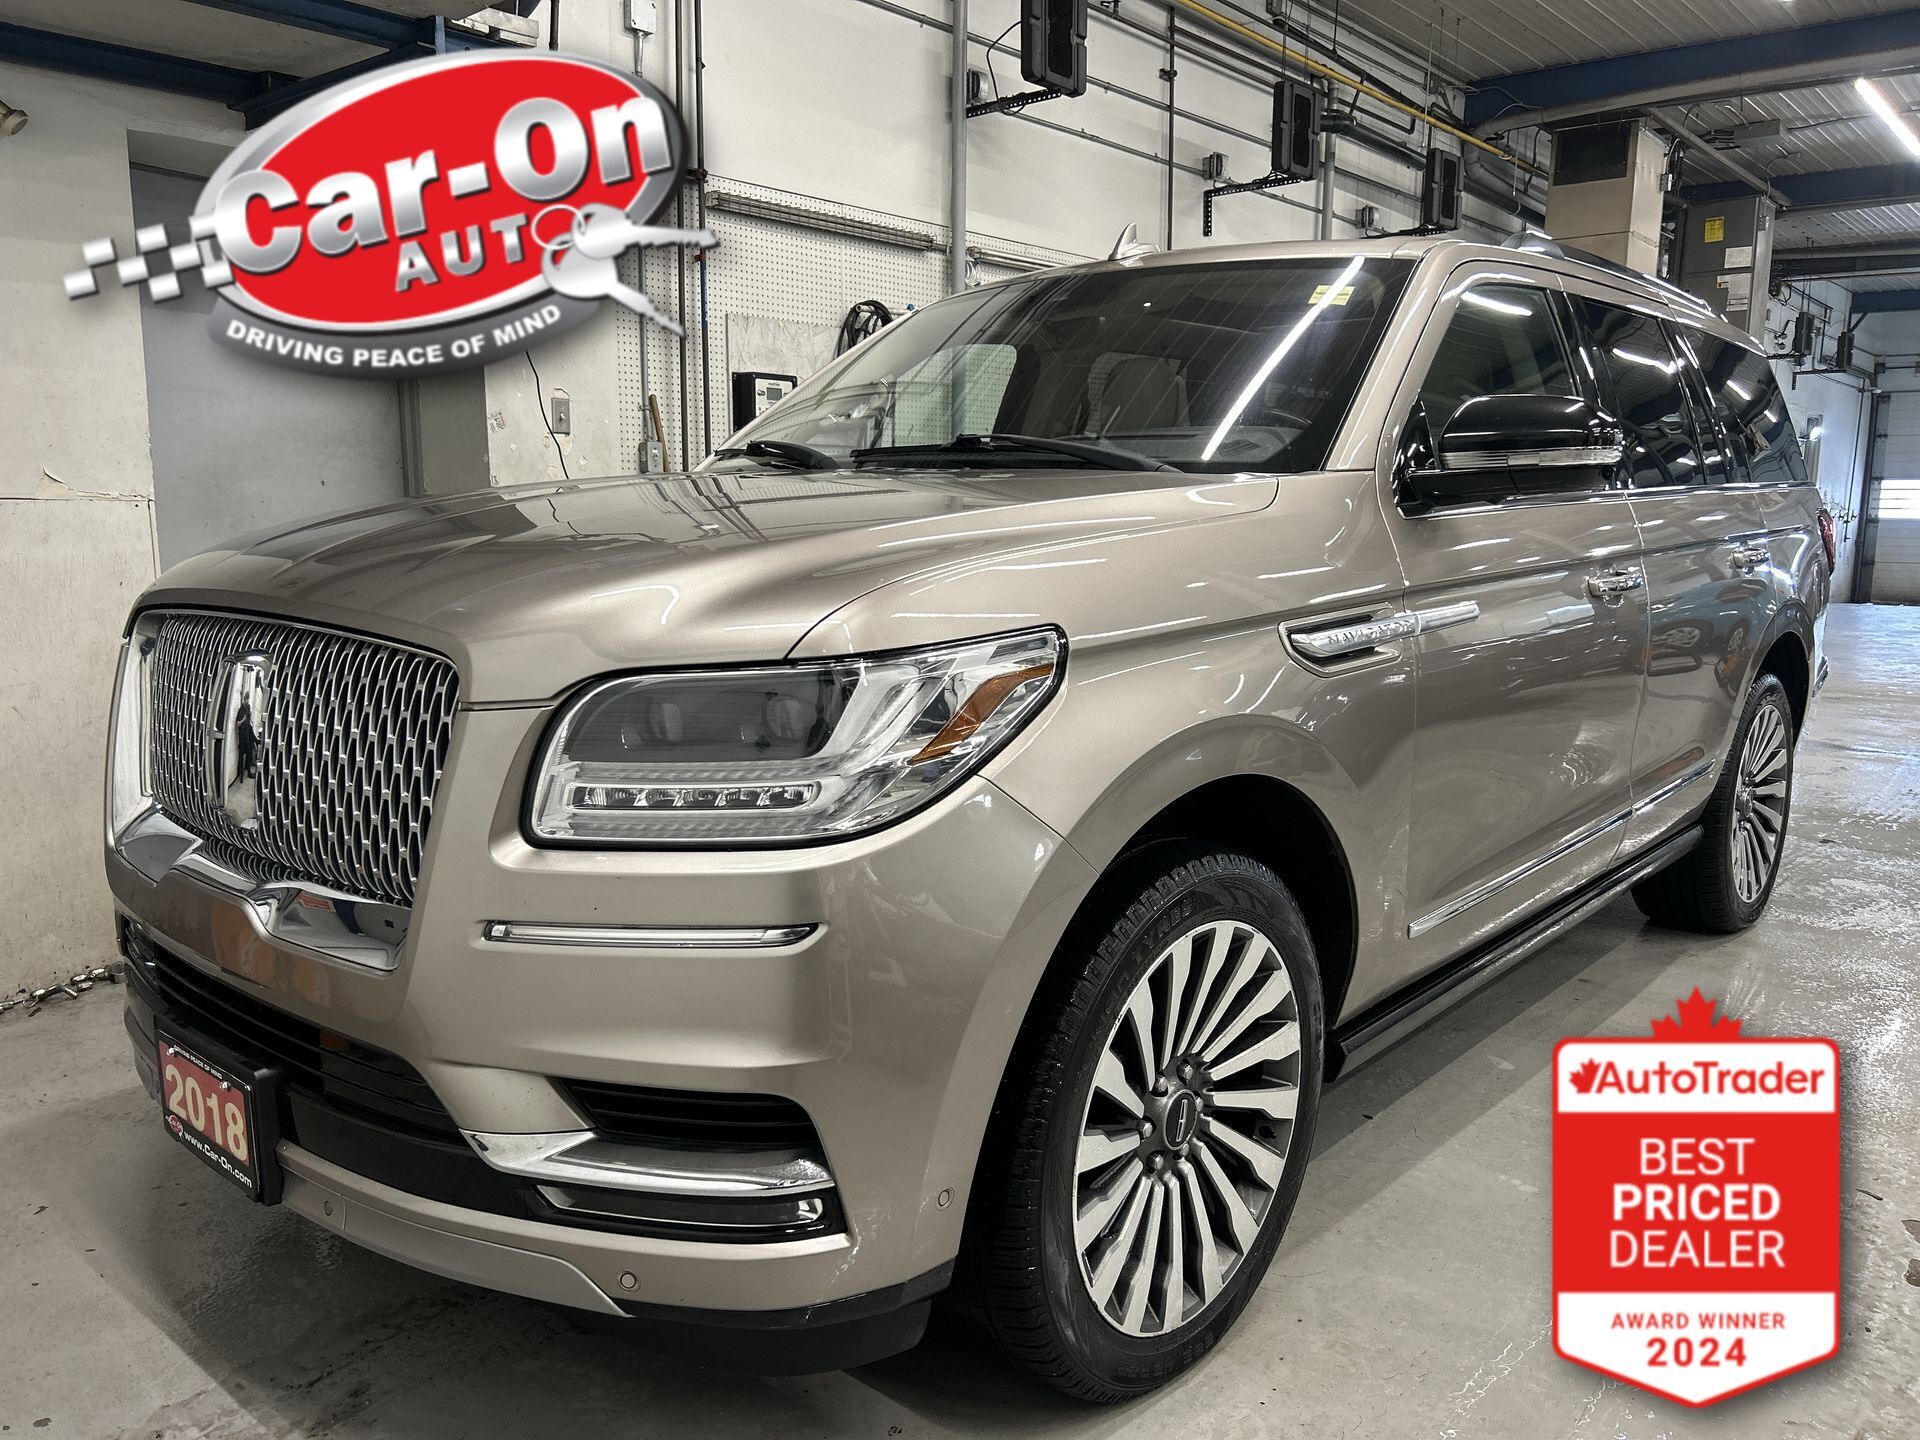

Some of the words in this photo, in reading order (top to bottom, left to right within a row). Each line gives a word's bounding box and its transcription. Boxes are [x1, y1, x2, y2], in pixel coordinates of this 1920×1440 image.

[1328, 619, 1413, 646] NAVIGATOR
[165, 1064, 247, 1162] 2018
[183, 1131, 253, 1189] www.Car-On.com
